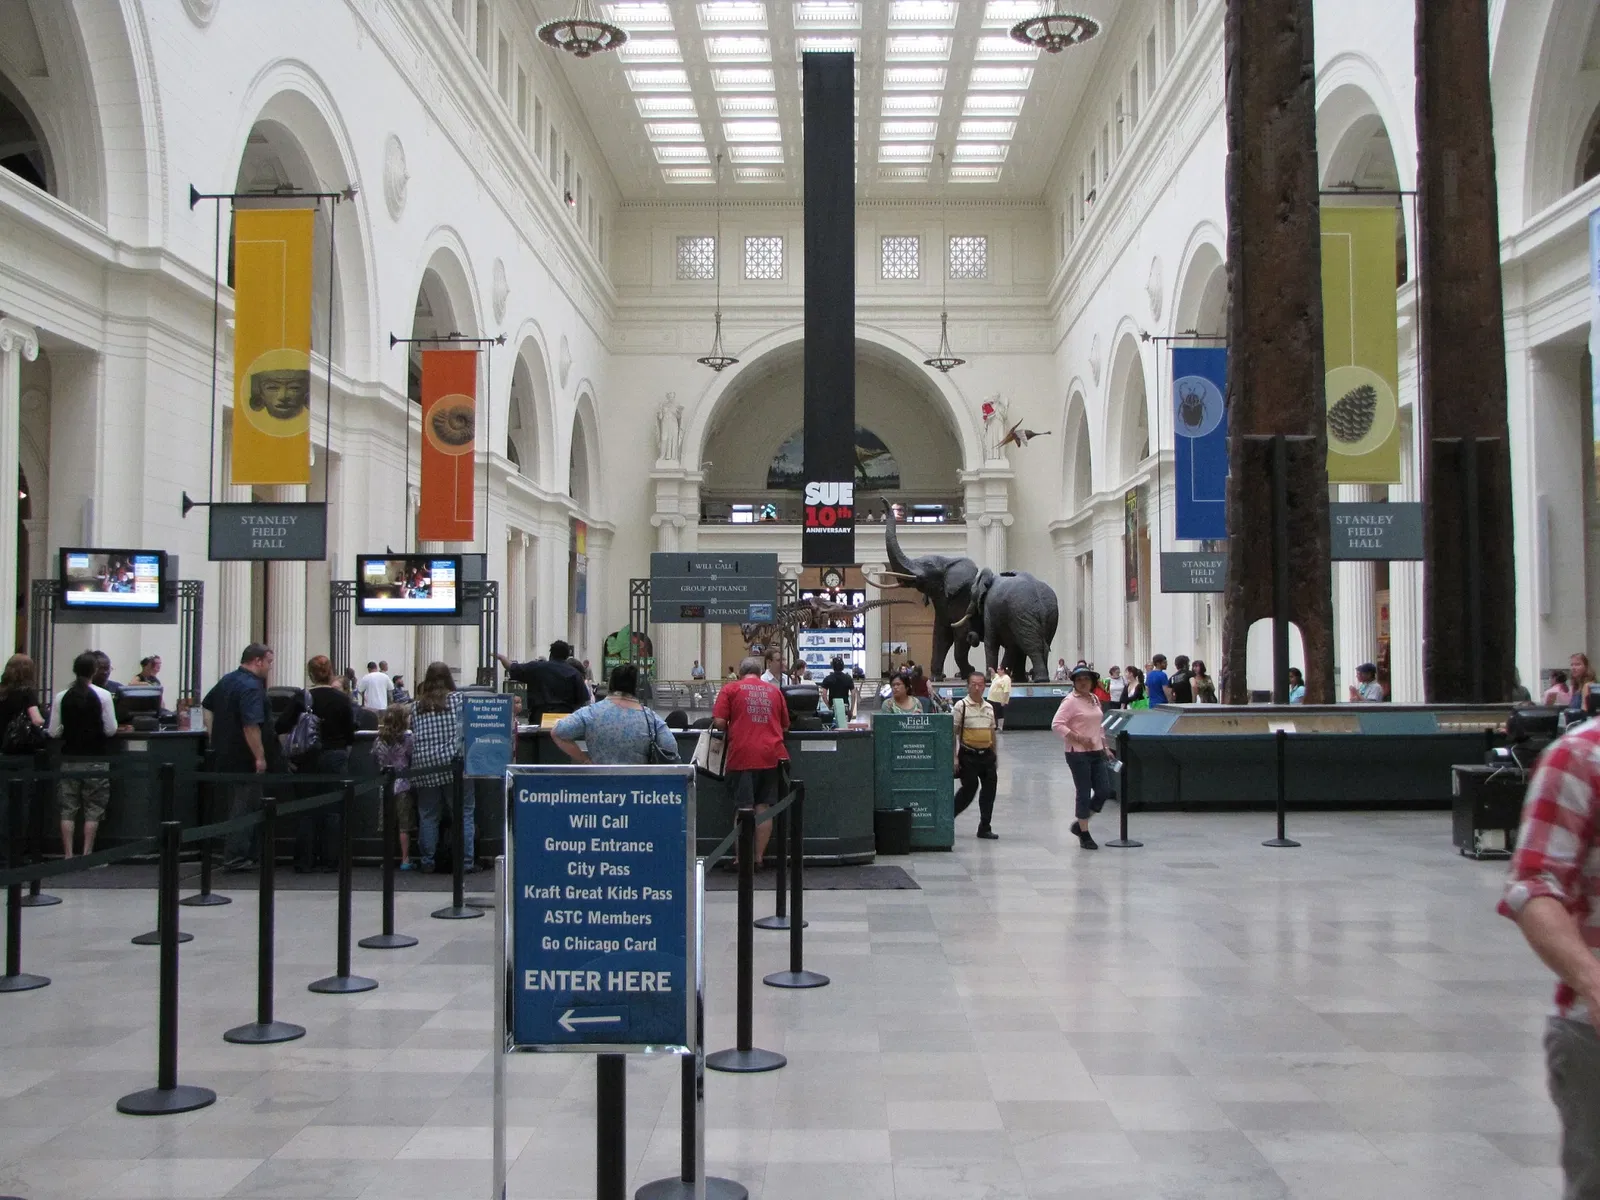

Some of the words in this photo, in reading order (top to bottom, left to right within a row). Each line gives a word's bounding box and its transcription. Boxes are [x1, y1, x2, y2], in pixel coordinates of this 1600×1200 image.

[805, 482, 853, 506] SUE
[241, 516, 298, 525] STANLEY
[805, 506, 852, 527] 10th
[1336, 515, 1394, 524] STANLEY
[252, 528, 287, 537] FIELD
[1347, 527, 1383, 536] FIELD
[252, 539, 286, 548] HALL
[1349, 539, 1383, 548] HALL
[907, 716, 929, 726] Field
[519, 789, 626, 805] Complimentary
[631, 791, 682, 805] Tickets
[569, 814, 597, 829] Will
[602, 814, 629, 829] Call
[545, 838, 586, 854] Group
[591, 838, 654, 852] Entrance
[567, 862, 595, 878] City
[600, 863, 630, 876] Pass
[524, 885, 561, 899] Kraft
[565, 886, 603, 900] Great
[608, 886, 638, 900] Kids
[643, 888, 673, 900] Pass
[544, 911, 583, 924] ASTC
[588, 911, 652, 925] Members
[542, 937, 560, 950] Go
[564, 937, 619, 953] Chicago
[624, 937, 657, 951] Card
[525, 970, 600, 991] ENTER
[608, 971, 672, 992] HERE
